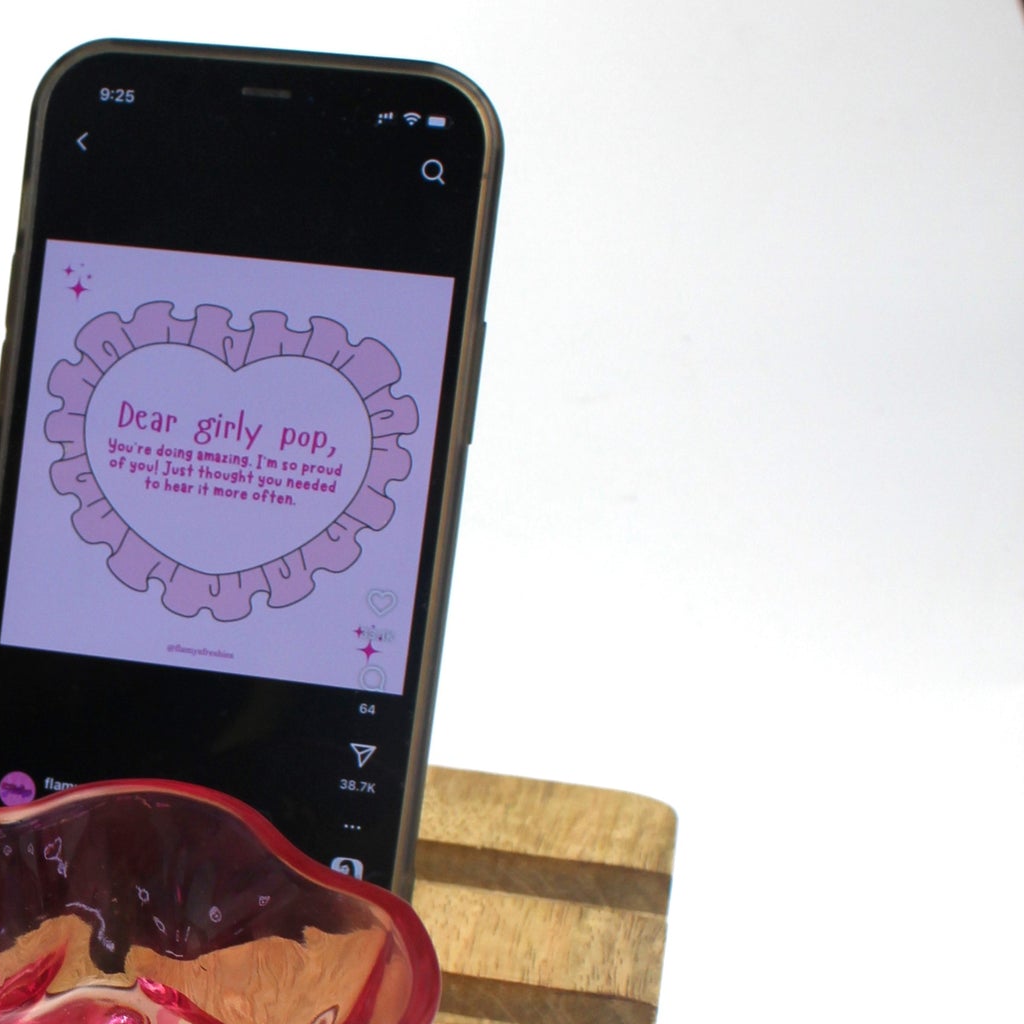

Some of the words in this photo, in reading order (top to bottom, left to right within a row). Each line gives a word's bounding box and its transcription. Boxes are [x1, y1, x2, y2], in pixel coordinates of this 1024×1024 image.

[100, 87, 135, 103] 9:25
[118, 401, 177, 433] Dear
[193, 410, 263, 450] girly
[280, 426, 336, 458] pop,
[108, 437, 151, 456] You're
[156, 445, 193, 461] doing
[196, 449, 252, 467] amazing.
[257, 454, 278, 469] I'm
[282, 461, 298, 472] so
[301, 464, 343, 477] proud
[109, 458, 126, 469] of
[130, 460, 159, 473] you!
[163, 464, 194, 477] Just
[198, 466, 254, 484] thought
[258, 475, 282, 487] you
[286, 477, 337, 493] needed
[145, 477, 160, 490] to
[164, 478, 194, 494] hear
[198, 484, 209, 496] it
[213, 488, 248, 500] more
[252, 491, 296, 506] often.
[359, 703, 376, 715] 64
[339, 778, 377, 794] 38.7K
